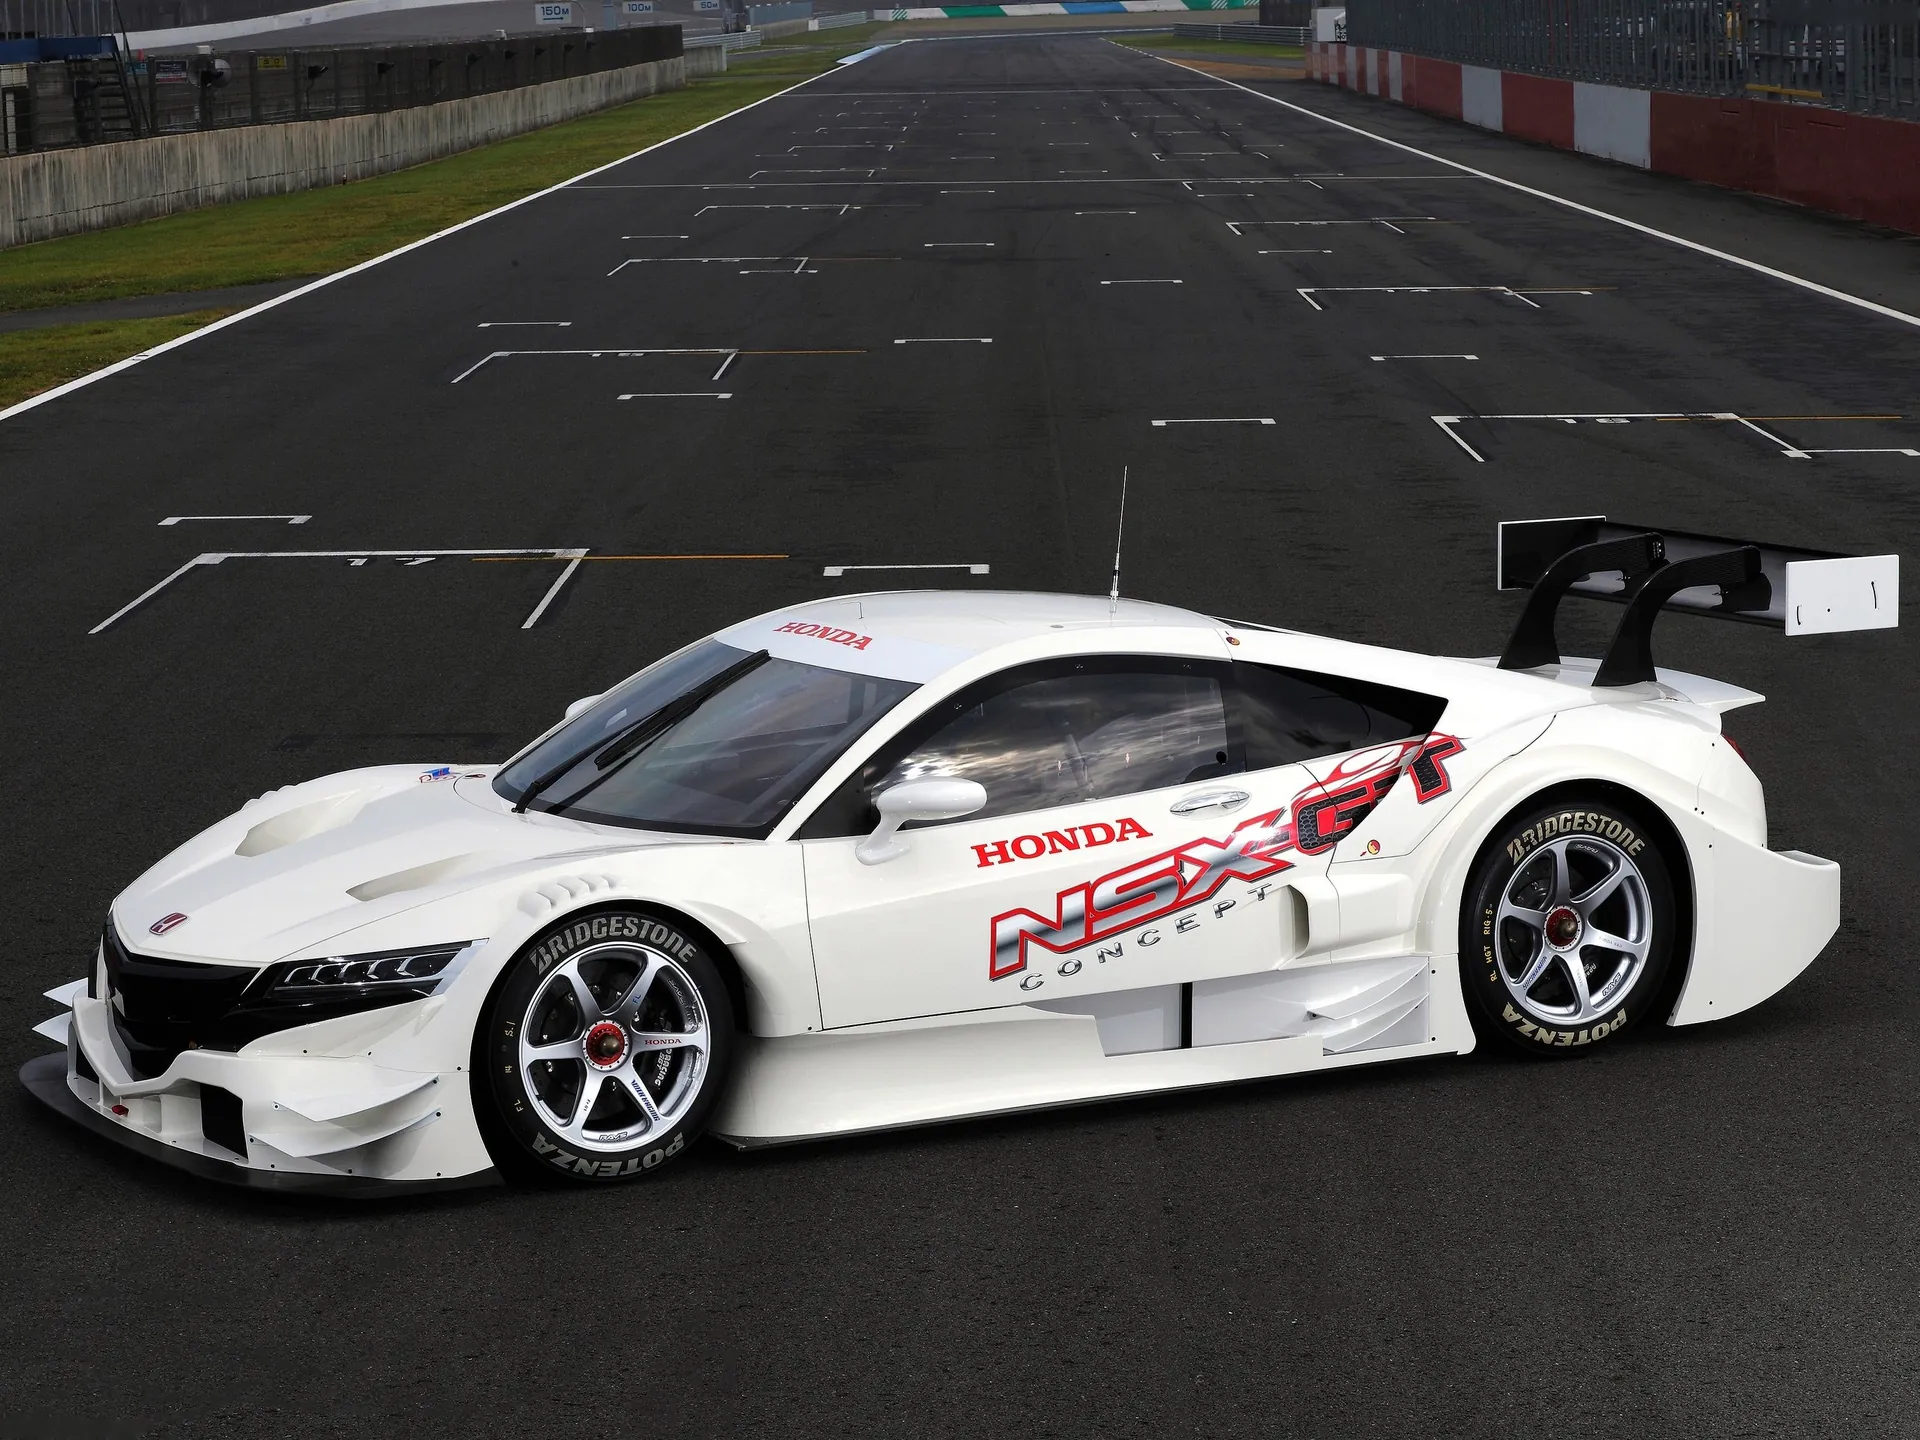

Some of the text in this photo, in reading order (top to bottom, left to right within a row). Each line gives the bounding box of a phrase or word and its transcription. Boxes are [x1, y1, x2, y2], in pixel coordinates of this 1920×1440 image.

[541, 6, 569, 15] 150M
[628, 3, 651, 12] 100M
[773, 622, 873, 651] HONDA
[971, 817, 1153, 868] HONDA
[1506, 811, 1646, 865] BRIDGESTONE
[529, 916, 697, 975] BRIDGESTONE
[1019, 882, 1273, 992] CONCEPT
[1502, 1001, 1627, 1046] POTENZA
[532, 1132, 685, 1177] POTENZA
